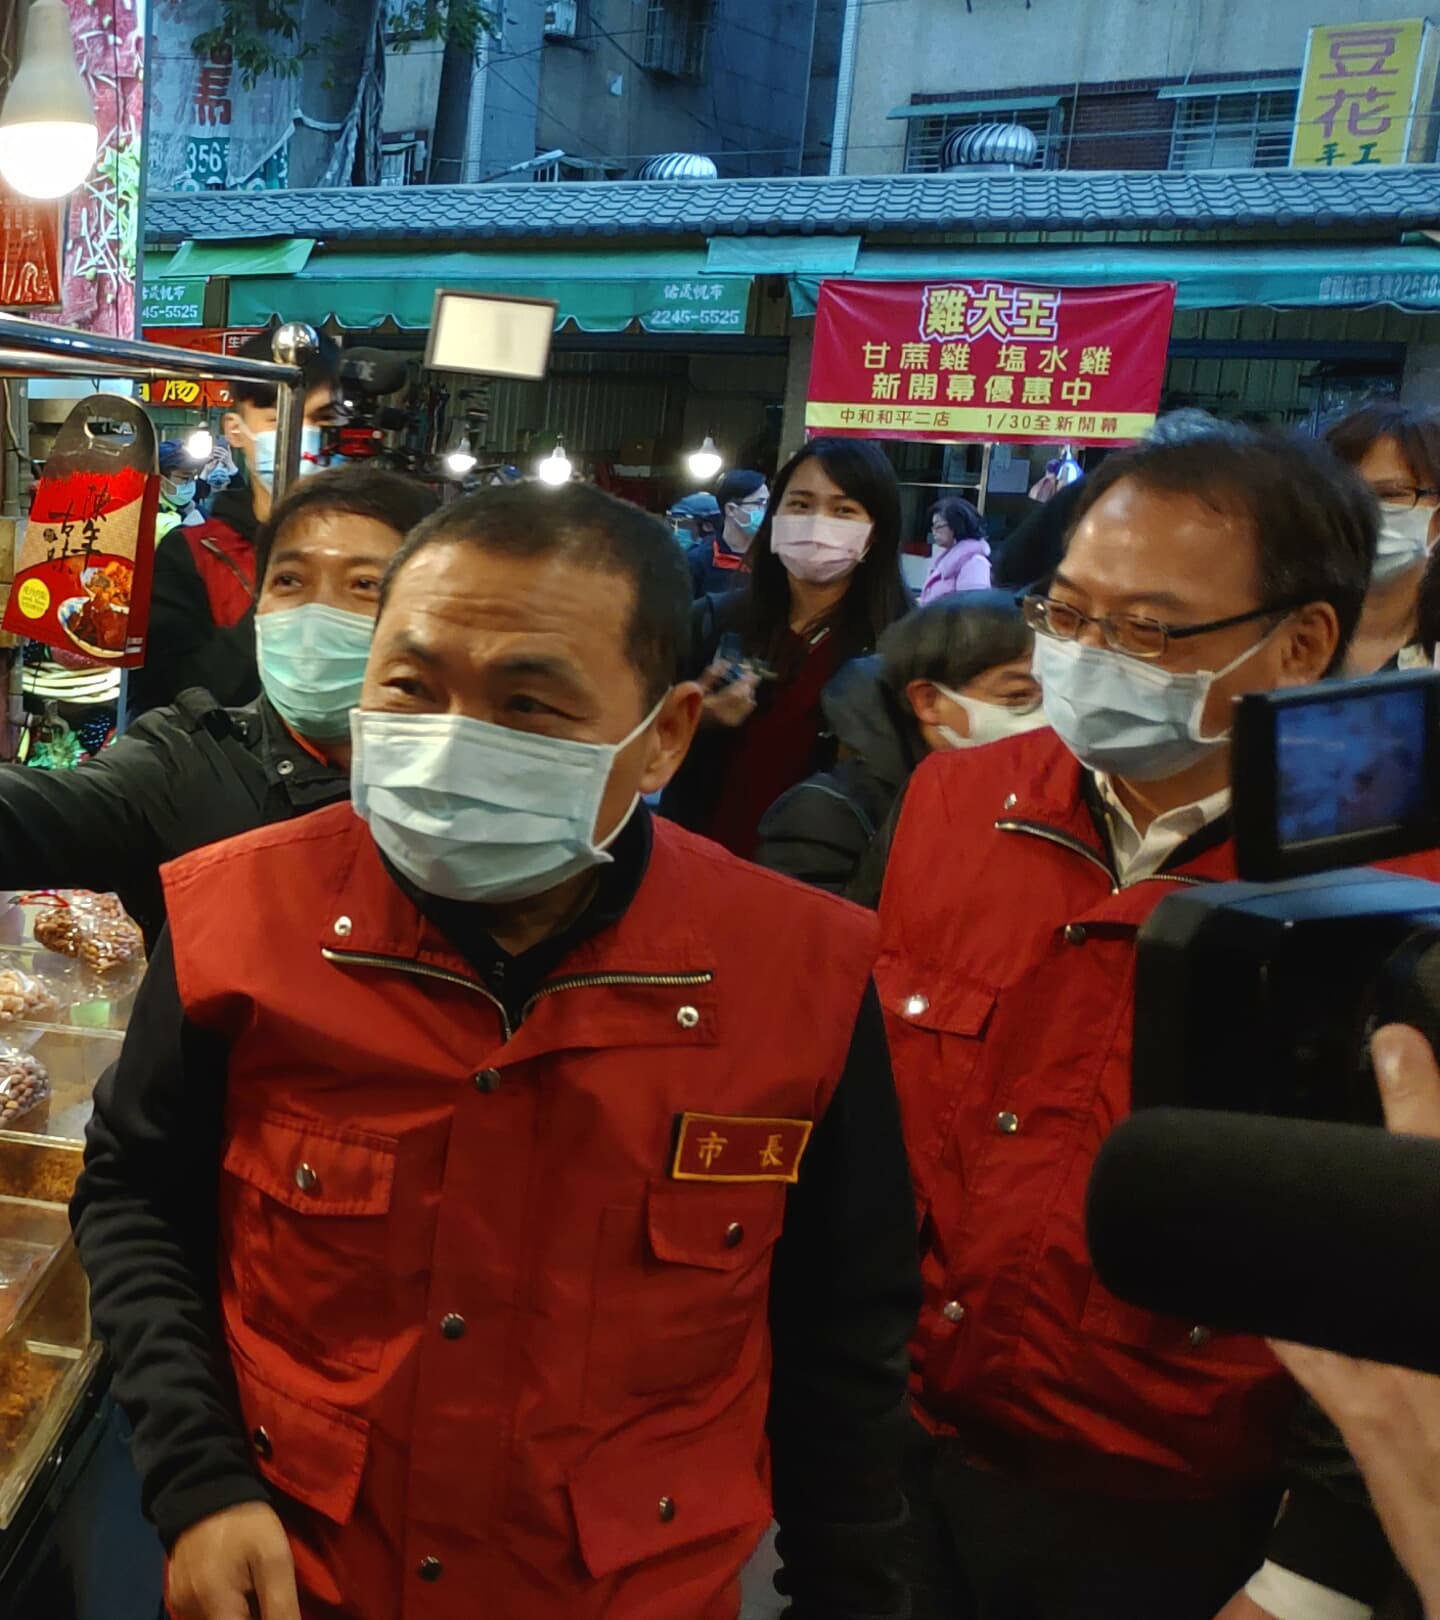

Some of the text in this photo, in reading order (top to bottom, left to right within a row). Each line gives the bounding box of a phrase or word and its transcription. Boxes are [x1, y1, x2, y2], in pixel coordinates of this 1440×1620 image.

[1313, 27, 1405, 139] 豆花
[650, 309, 740, 324] 2245-5525
[923, 288, 1059, 338] 雞大王
[862, 341, 1112, 376] 甘蔗雞 塩水雞
[872, 372, 1093, 406] 新開幕優惠中
[840, 407, 1119, 433] 中和和平二店 1/30全新開幕
[696, 1130, 784, 1168] 市長
